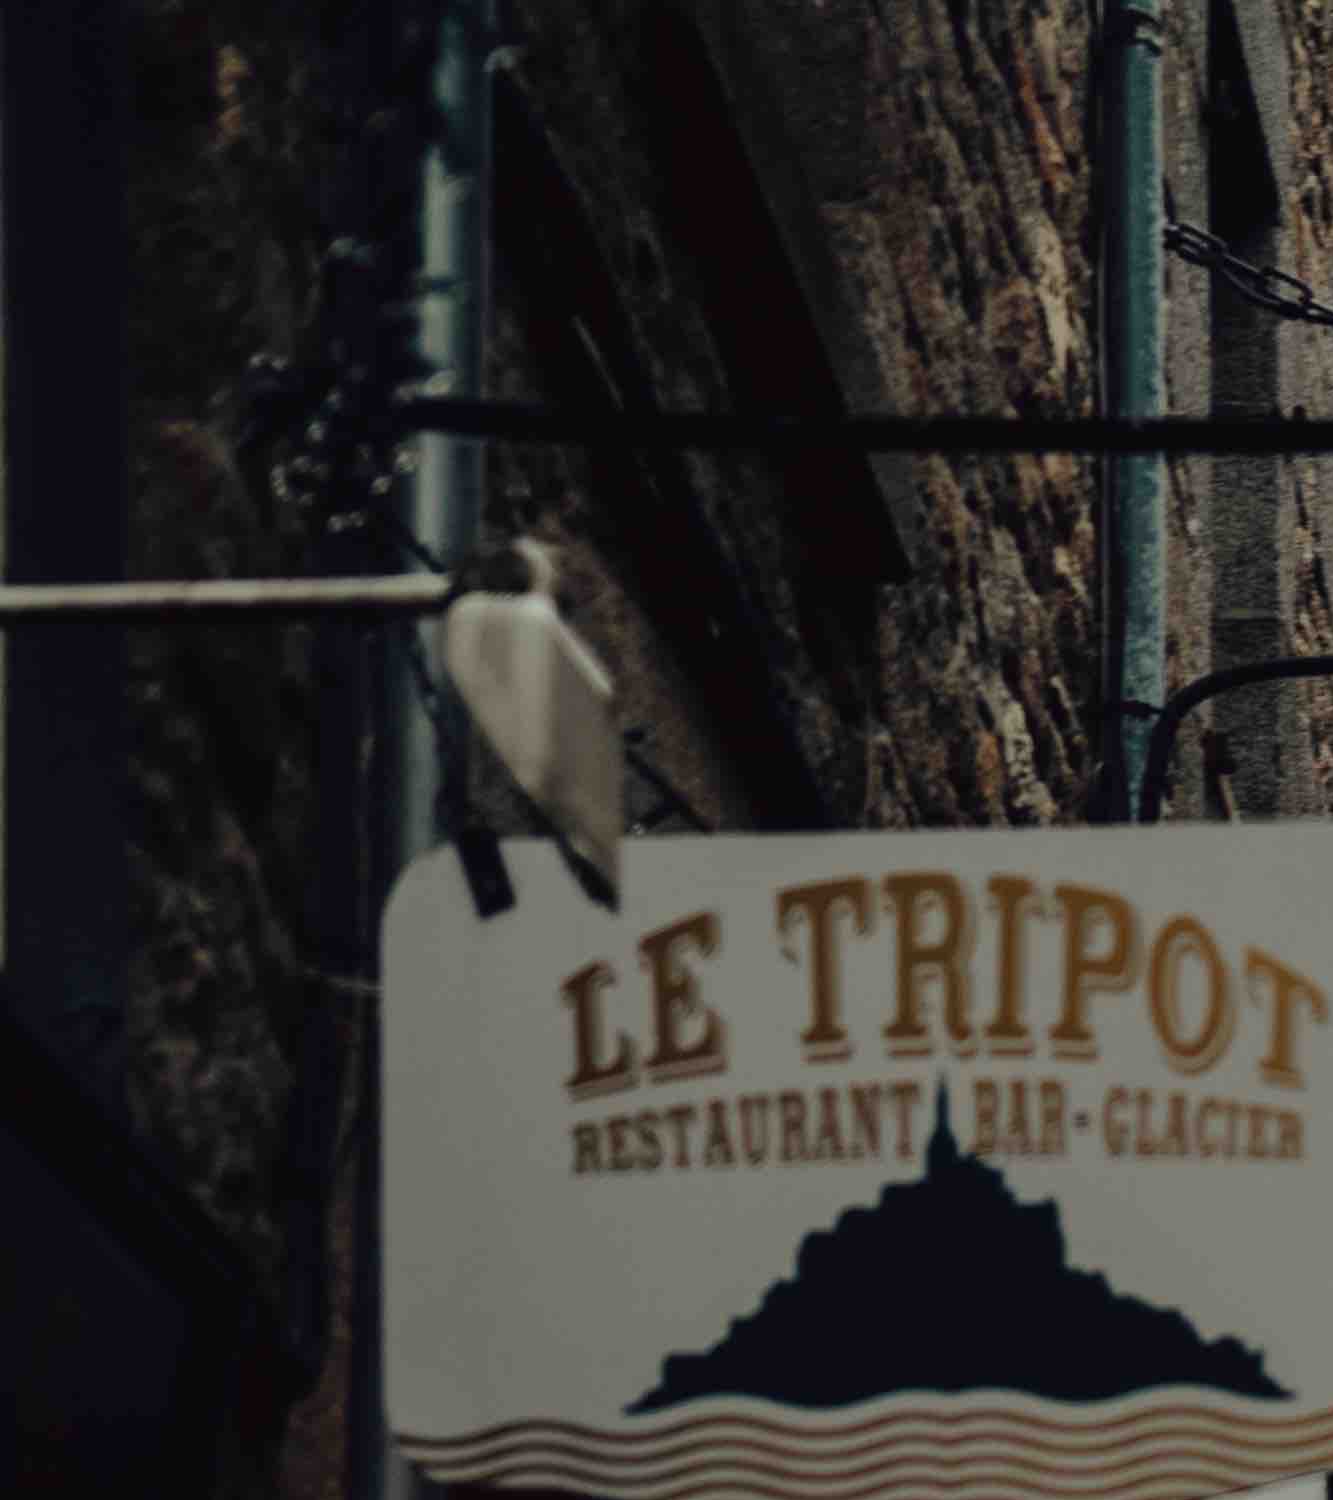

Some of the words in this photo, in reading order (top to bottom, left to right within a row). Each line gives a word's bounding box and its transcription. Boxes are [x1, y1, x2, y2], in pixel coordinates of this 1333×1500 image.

[562, 911, 722, 1098] LE
[776, 872, 1328, 1090] TRIPOT
[573, 1084, 921, 1174] RESTAURANT
